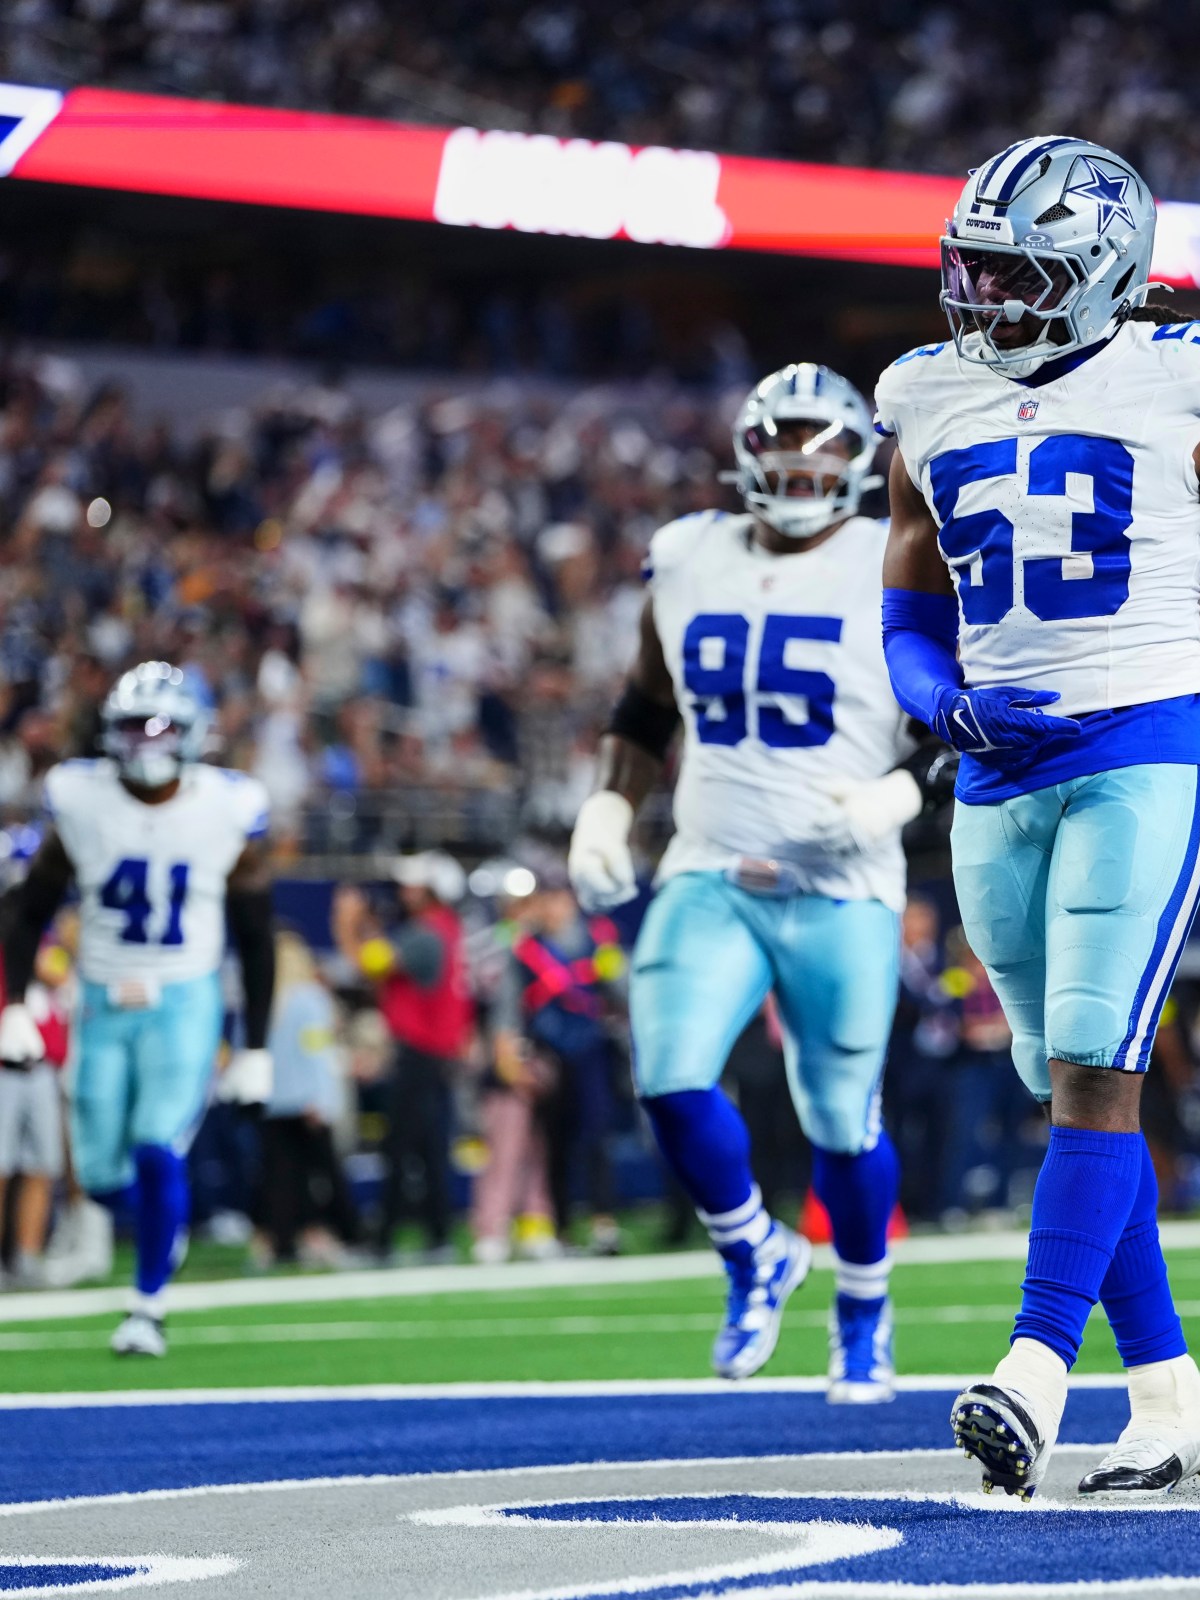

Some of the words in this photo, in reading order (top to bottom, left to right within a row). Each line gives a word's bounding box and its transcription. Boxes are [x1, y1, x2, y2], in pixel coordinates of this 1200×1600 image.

[966, 218, 1002, 231] COWBOYS
[1019, 408, 1034, 419] NFL
[929, 434, 1135, 625] 53
[682, 613, 844, 748] 95
[101, 858, 190, 945] 41
